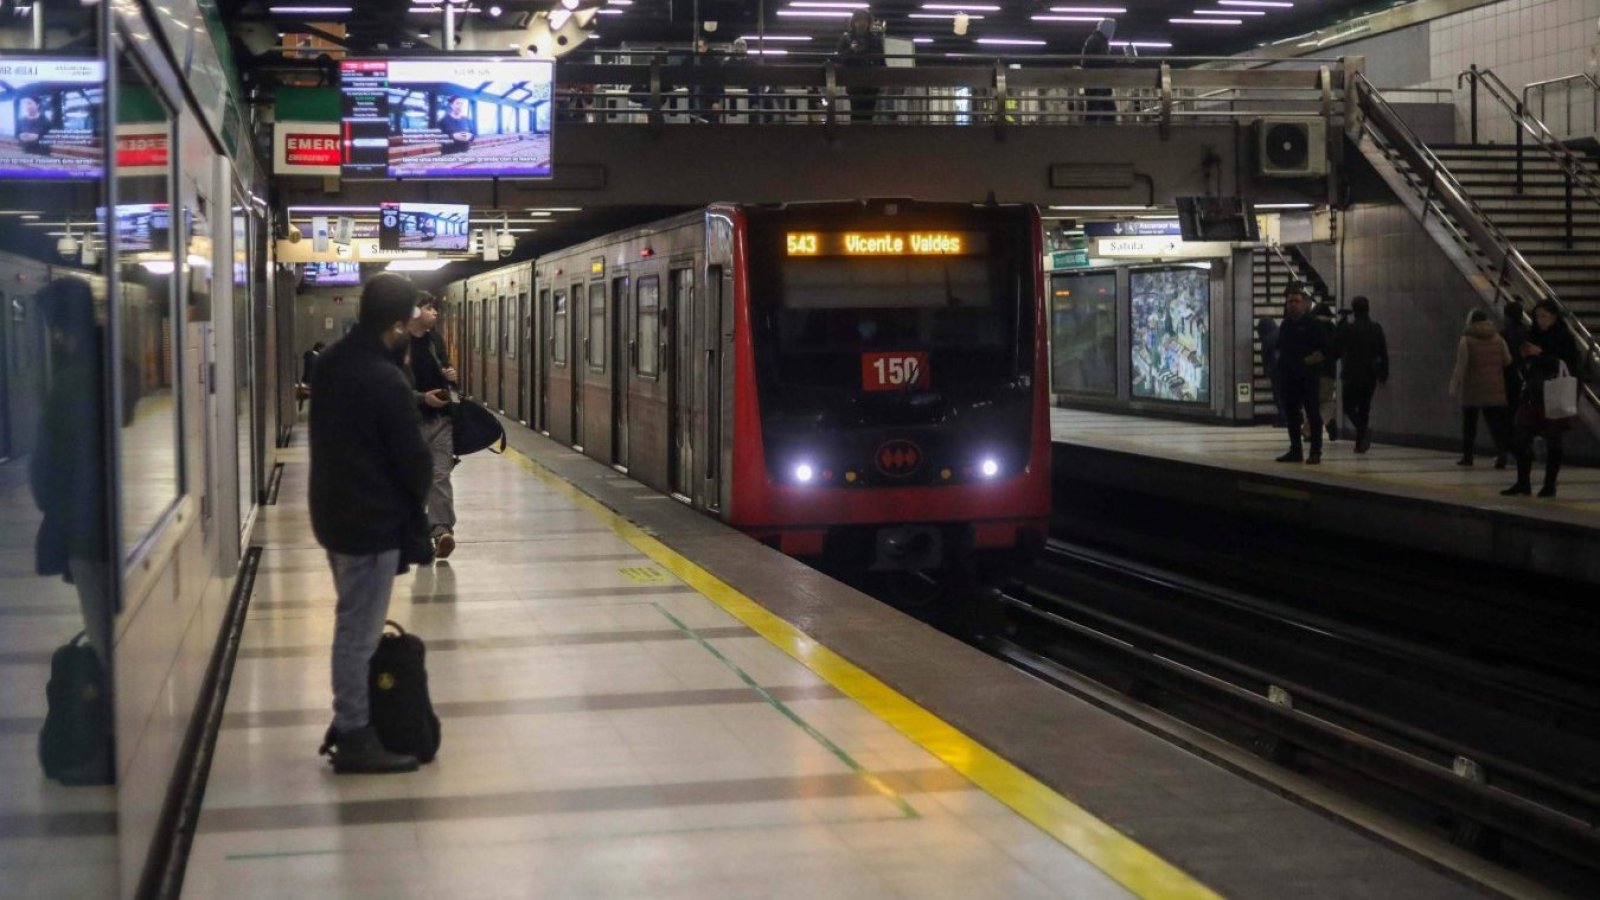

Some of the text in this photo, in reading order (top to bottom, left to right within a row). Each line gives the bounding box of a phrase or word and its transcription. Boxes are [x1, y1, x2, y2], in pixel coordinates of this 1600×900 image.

[787, 233, 961, 253] 543 Vicente Valdés
[873, 356, 920, 385] 150
